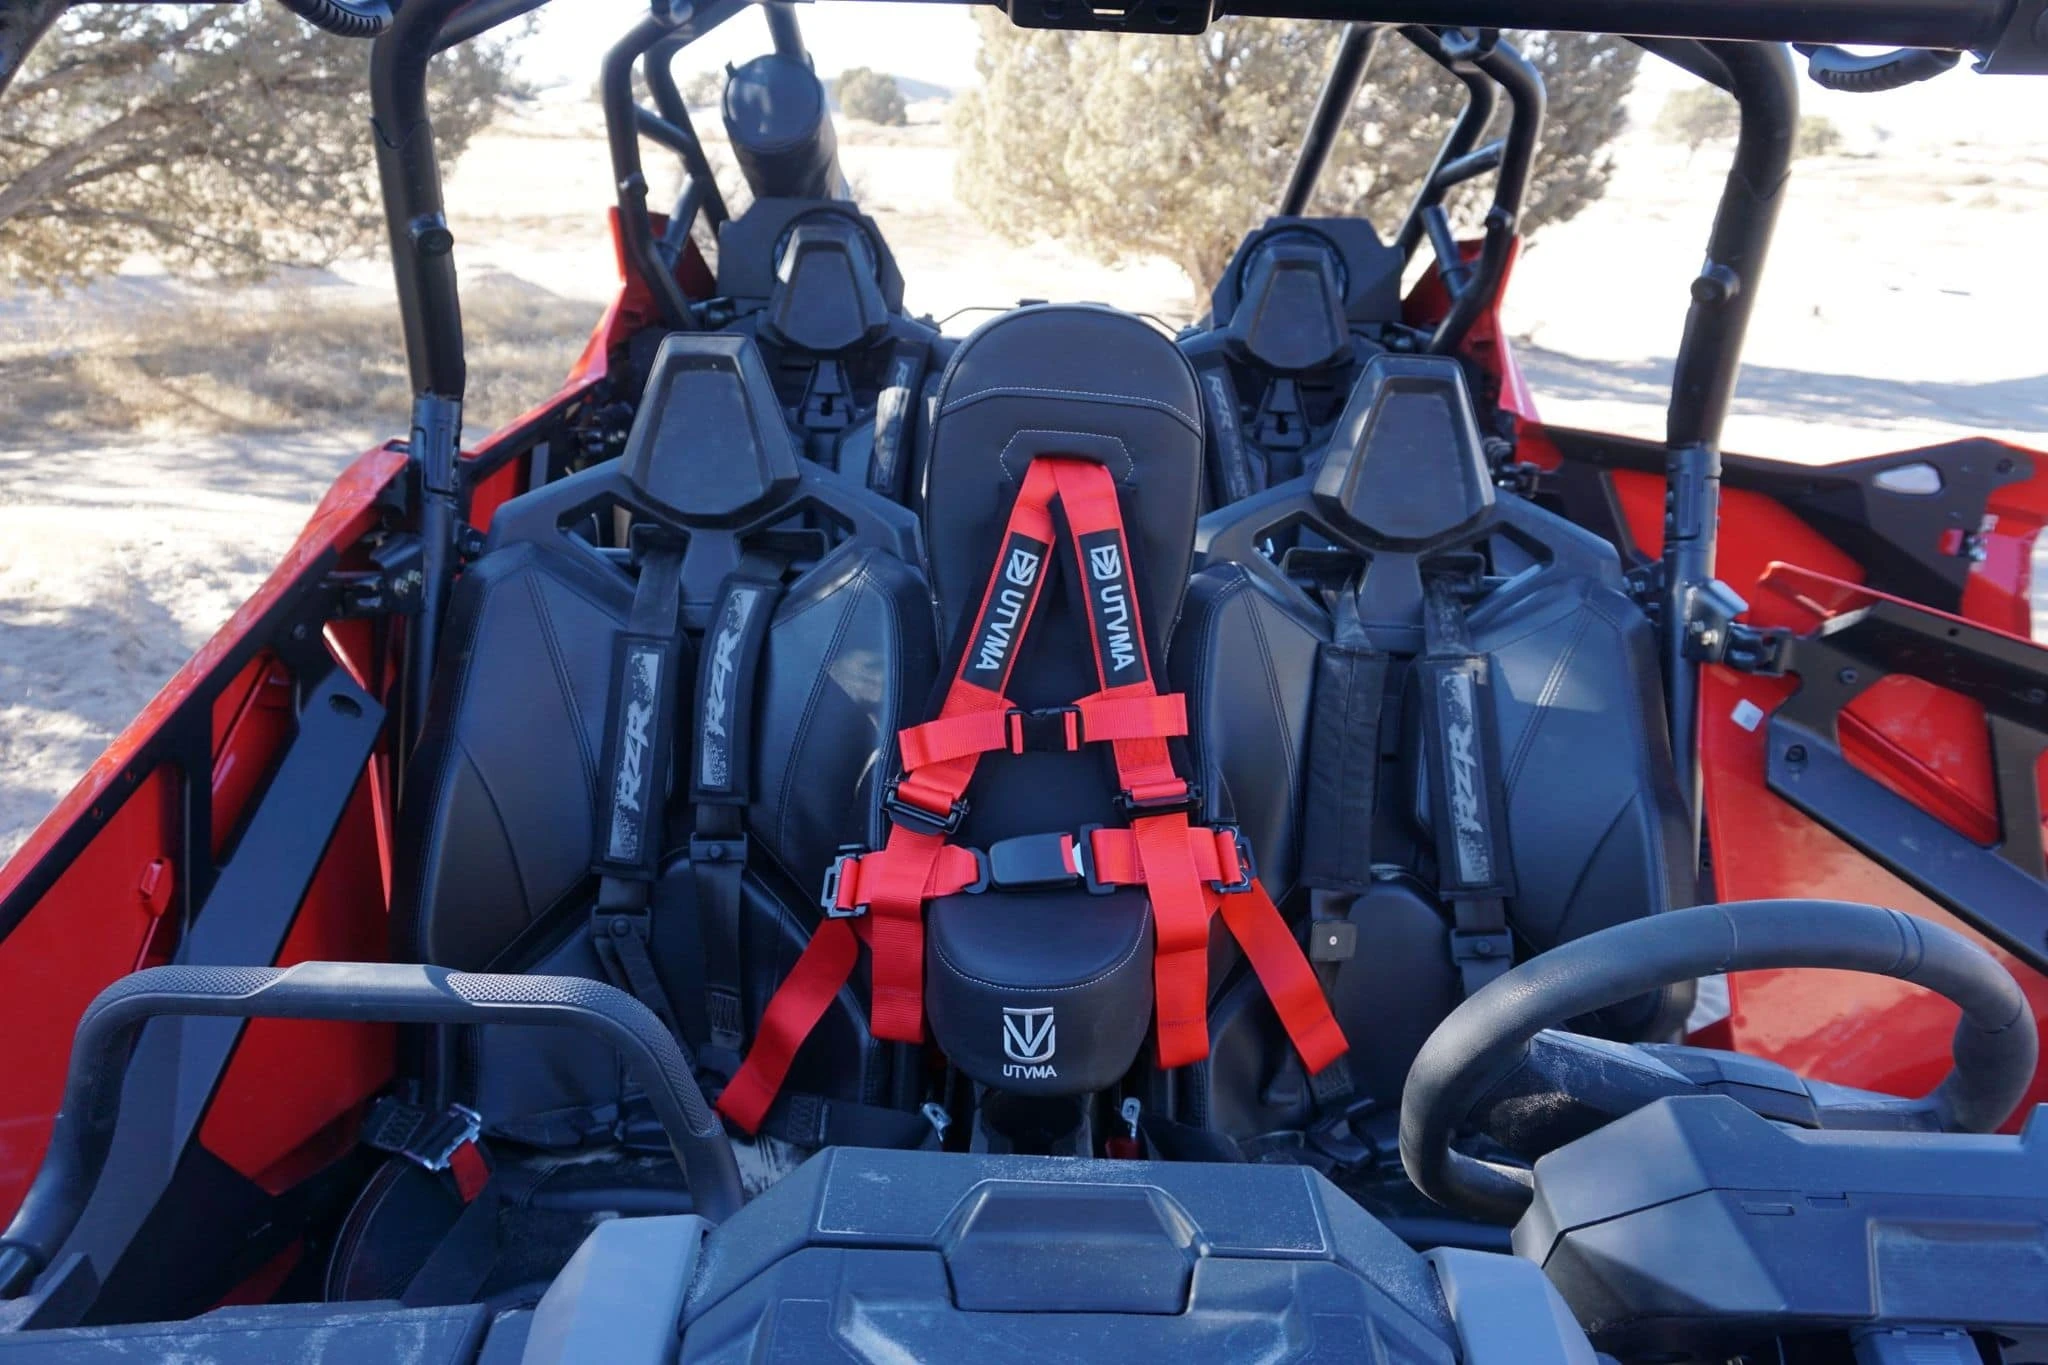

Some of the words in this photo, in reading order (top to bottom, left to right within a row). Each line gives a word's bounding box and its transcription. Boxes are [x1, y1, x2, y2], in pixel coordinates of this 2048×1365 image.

[975, 588, 1025, 671] UTVMA
[1100, 584, 1136, 672] UTVMA
[705, 629, 741, 737] RZR
[616, 699, 653, 812] RZR
[1449, 723, 1483, 833] RZR
[1003, 1064, 1057, 1079] UTVMA
